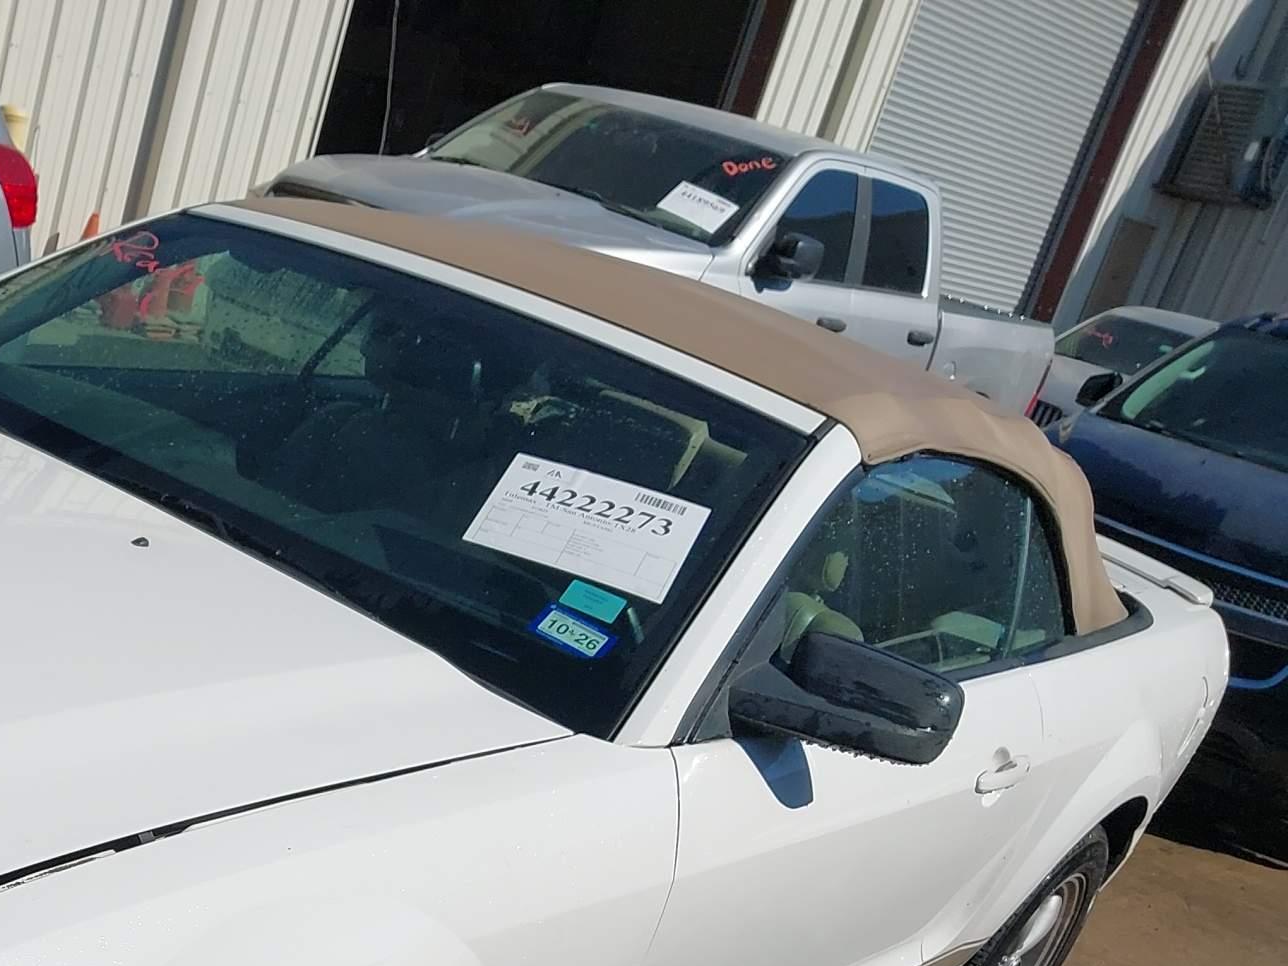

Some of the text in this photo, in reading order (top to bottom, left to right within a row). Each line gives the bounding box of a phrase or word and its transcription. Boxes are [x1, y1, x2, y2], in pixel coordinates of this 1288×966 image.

[721, 156, 777, 176] Done
[520, 480, 673, 536] 44222273
[547, 619, 570, 635] 10
[574, 633, 600, 650] 26
